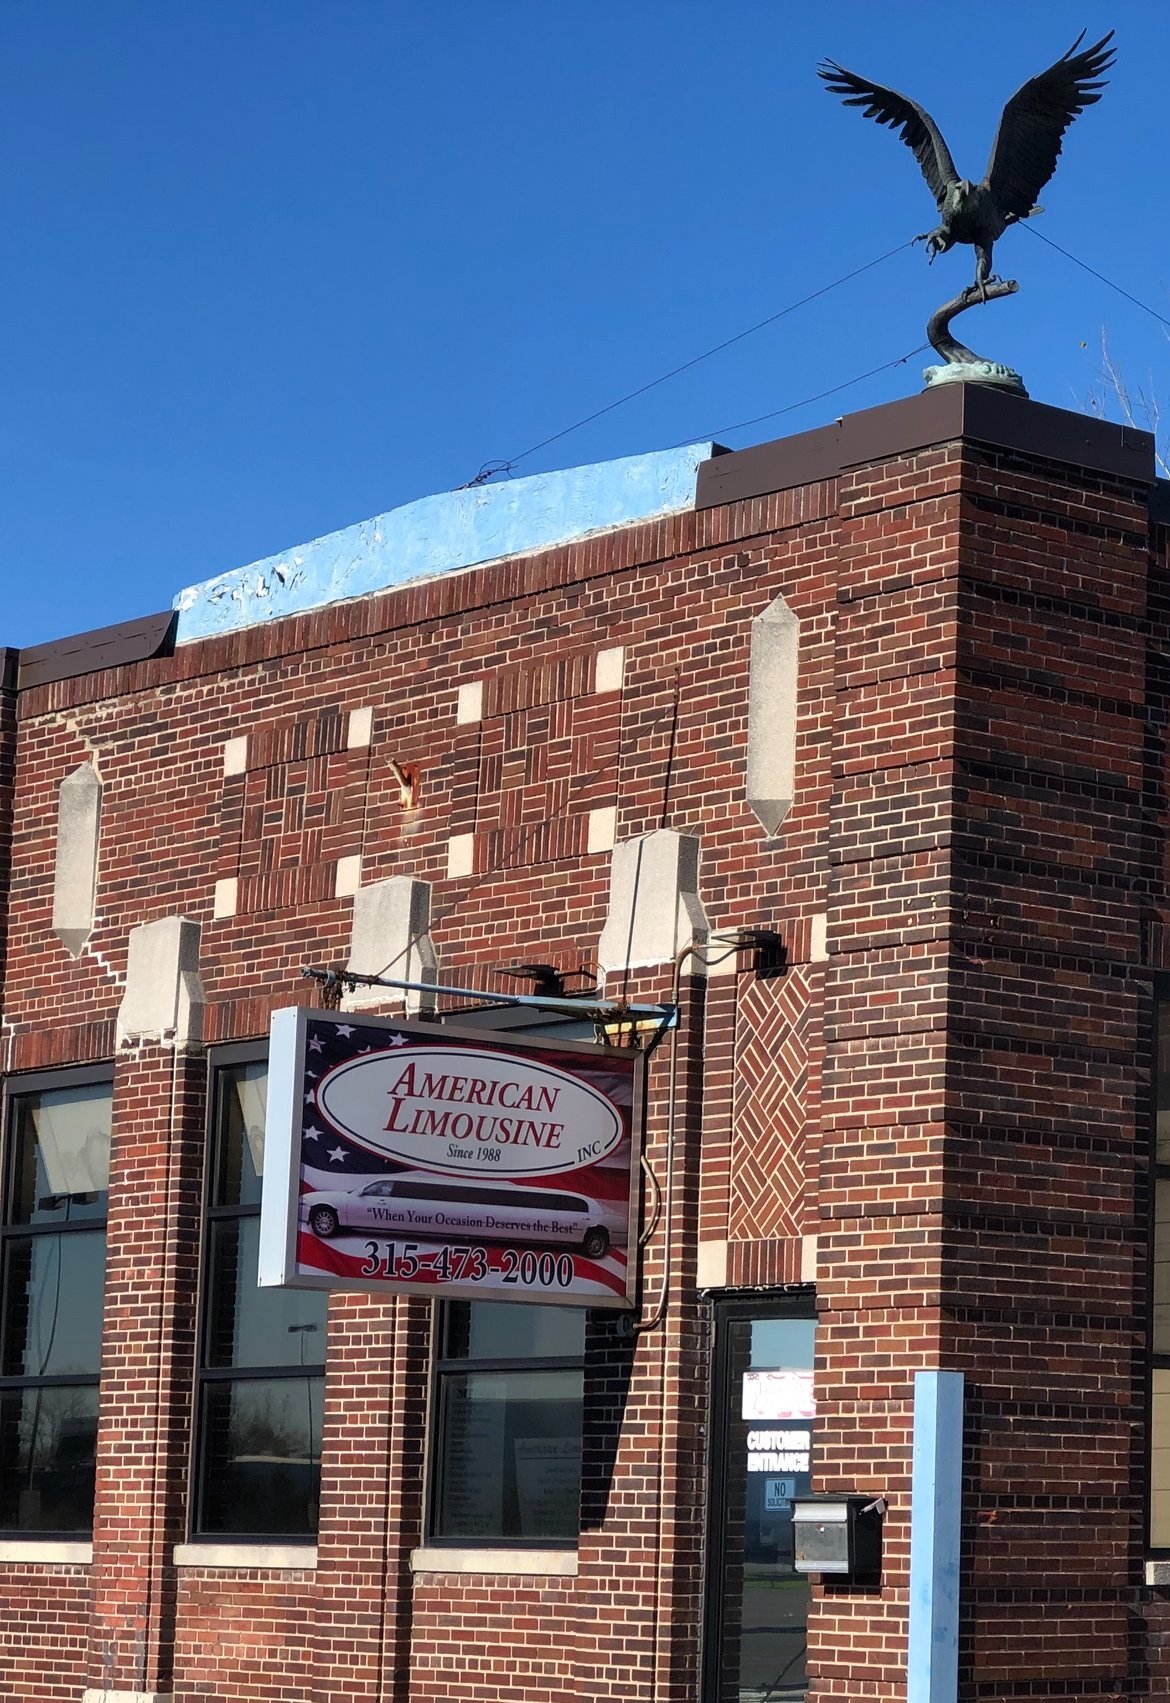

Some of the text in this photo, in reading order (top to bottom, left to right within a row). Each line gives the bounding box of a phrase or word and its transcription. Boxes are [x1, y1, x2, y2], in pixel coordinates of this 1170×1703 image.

[386, 1061, 562, 1113] AMERICAN
[382, 1096, 565, 1150] LIMOUSINE
[446, 1143, 502, 1163] Since 1988
[576, 1140, 603, 1163] INC
[406, 1210, 433, 1224] Your
[435, 1212, 483, 1228] Occasion
[485, 1216, 531, 1231] Deserves
[532, 1220, 549, 1232] the
[361, 1239, 575, 1288] 315-473-2000
[746, 1430, 811, 1451] CUSTOMER
[746, 1452, 810, 1473] ENTRANCE
[774, 1482, 786, 1497] NO
